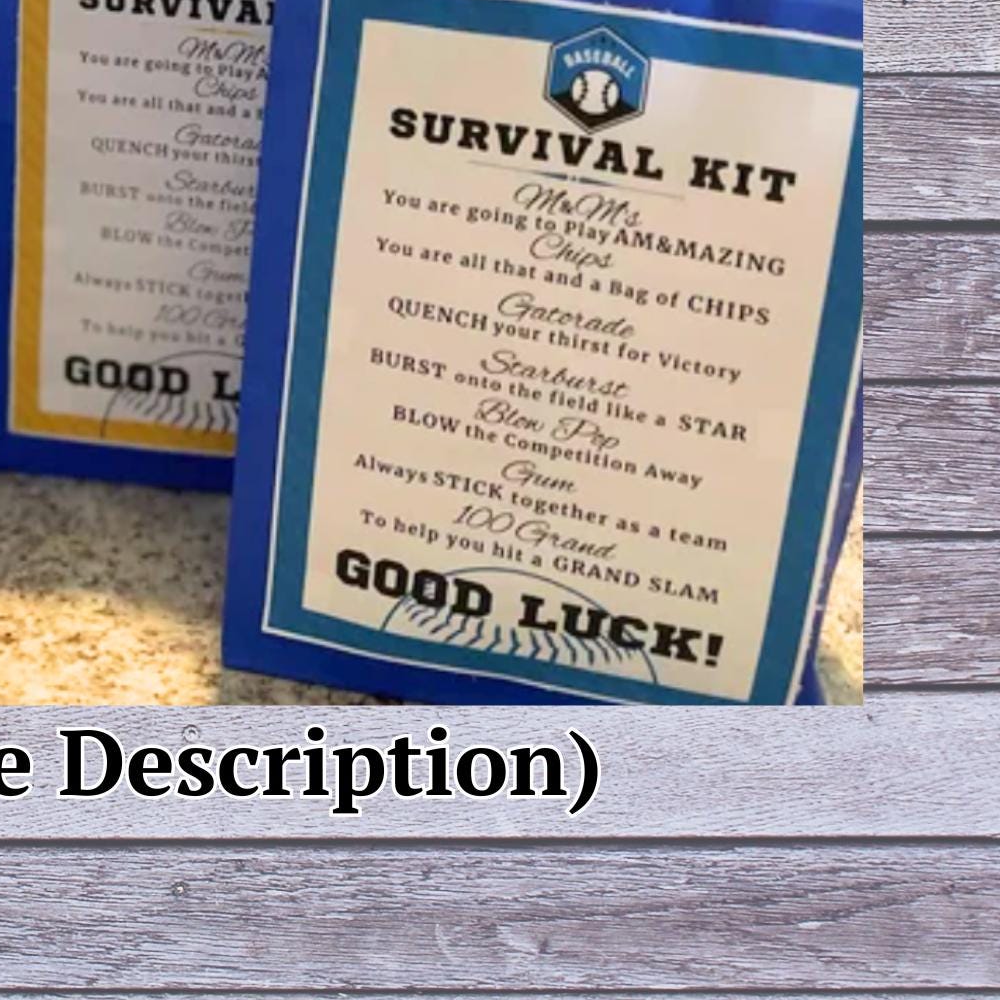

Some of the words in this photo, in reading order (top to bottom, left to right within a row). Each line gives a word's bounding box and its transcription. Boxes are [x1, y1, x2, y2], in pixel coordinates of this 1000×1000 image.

[79, 50, 109, 66] You
[114, 56, 139, 68] are
[144, 57, 191, 74] going
[195, 63, 215, 76] to
[218, 65, 252, 81] Play
[563, 49, 636, 80] BASEBALL
[77, 90, 107, 105] You
[112, 94, 136, 107] are
[142, 95, 163, 110] all
[168, 99, 201, 114] that
[207, 104, 237, 117] and
[90, 137, 168, 158] QUENCH
[172, 147, 209, 162] your
[389, 107, 664, 182] SURVIVAL
[688, 154, 797, 204] KIT
[511, 183, 644, 228] M&M's
[382, 189, 421, 210] You
[427, 199, 461, 217] are
[466, 206, 528, 231] going
[535, 215, 557, 233] to
[563, 220, 610, 245] Play
[613, 227, 786, 277] AM&MAZING
[527, 232, 616, 270] Chips
[376, 237, 414, 256] You
[419, 247, 453, 265] are
[459, 252, 486, 271] all
[494, 258, 537, 281] that
[543, 269, 583, 289] and
[589, 278, 601, 291] a
[608, 280, 649, 306] Bag
[655, 291, 680, 309] of
[686, 294, 771, 327] CHIPS
[387, 295, 488, 333] QUENCH
[492, 319, 542, 342] your
[548, 331, 610, 357] thirst
[617, 343, 649, 364] for
[657, 352, 743, 384] Victory
[497, 291, 637, 340] Gatorade
[64, 355, 190, 396] GOOD
[370, 347, 448, 380] BURST
[453, 370, 502, 393] onto
[508, 382, 543, 402] the
[548, 389, 599, 414] field
[606, 402, 649, 425] like
[654, 414, 666, 427] a
[678, 414, 748, 442] STAR
[480, 350, 632, 399] Starburst
[392, 405, 461, 434] BLOW
[465, 424, 498, 443] the
[503, 433, 638, 475] Competition
[642, 463, 704, 491] Away
[472, 397, 546, 434] Blow
[550, 416, 620, 450] Pop
[353, 453, 429, 486] Always
[433, 471, 504, 500] STICK
[511, 491, 609, 527] together
[615, 516, 640, 534] as
[648, 524, 661, 537] a
[669, 528, 728, 552] team
[500, 459, 579, 493] Gum
[359, 509, 387, 528] To
[393, 518, 440, 544] help
[445, 532, 486, 556] you
[492, 541, 524, 563] hit
[530, 554, 543, 568] a
[552, 554, 641, 588] GRAND
[647, 576, 719, 605] SLAM
[451, 504, 513, 535] 100
[515, 519, 618, 561] Grand
[335, 548, 493, 618] GOOD
[518, 594, 725, 668] LUCK!
